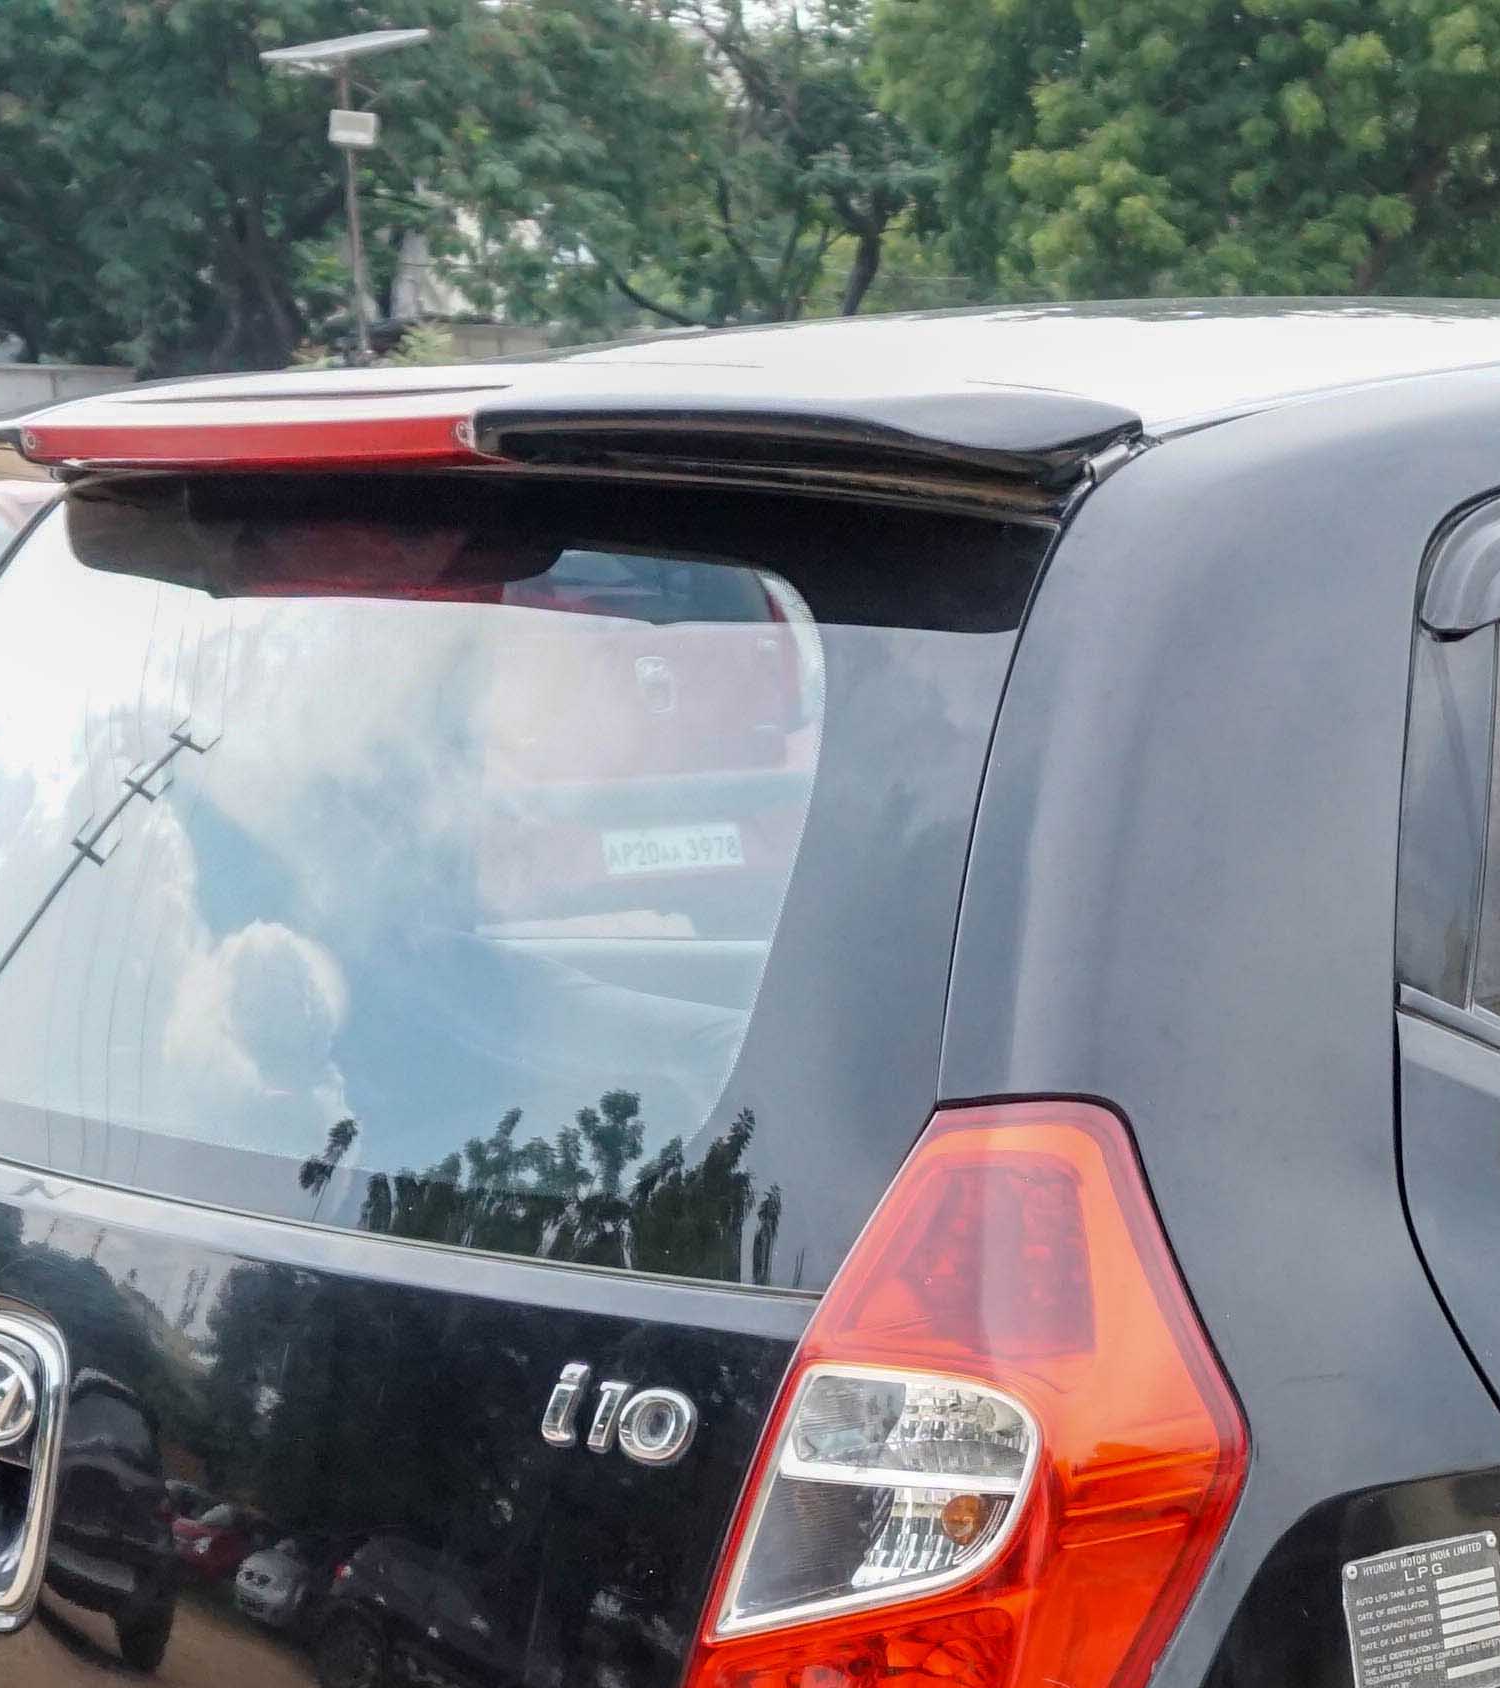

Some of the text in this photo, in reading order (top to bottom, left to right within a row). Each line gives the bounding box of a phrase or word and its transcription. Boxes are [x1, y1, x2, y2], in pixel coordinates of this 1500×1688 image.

[1363, 1541, 1482, 1577] HYUNDAI MOTOR INDIA LIMITED
[1390, 1634, 1407, 1645] LAST
